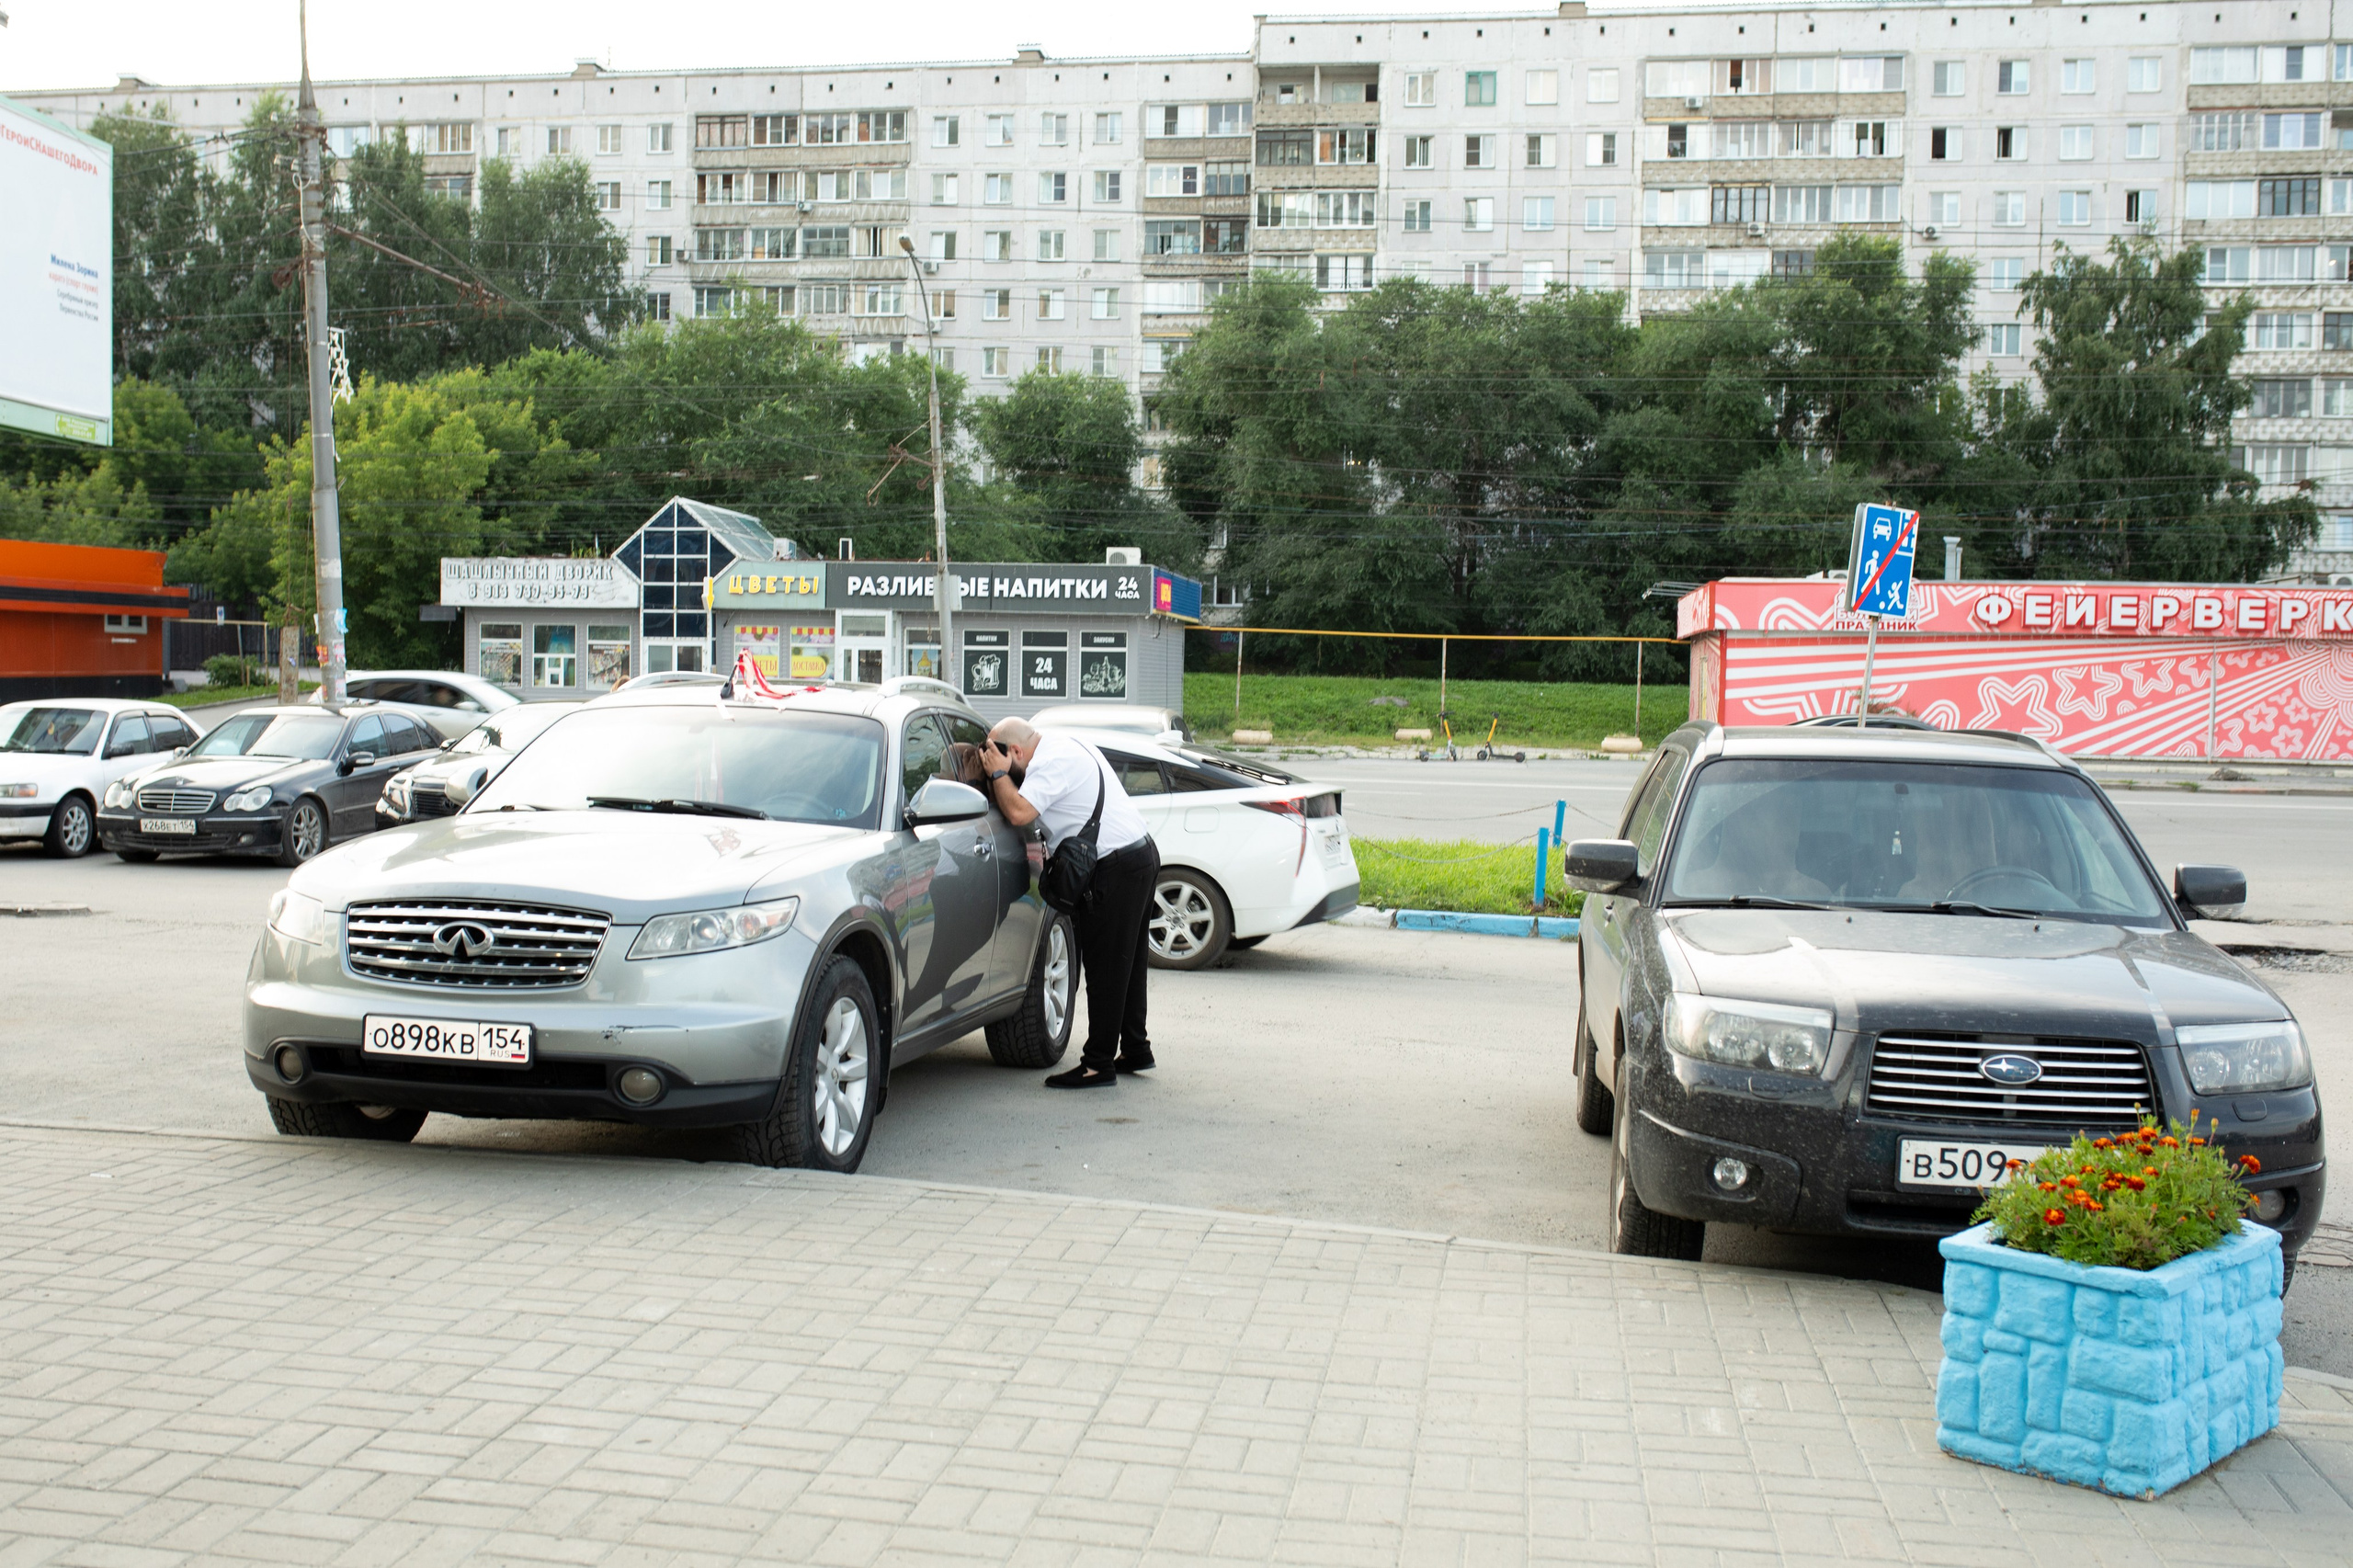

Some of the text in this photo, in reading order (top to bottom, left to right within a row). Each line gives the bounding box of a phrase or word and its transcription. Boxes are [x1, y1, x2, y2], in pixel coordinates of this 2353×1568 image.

[447, 563, 613, 581] ШАШЛЫЧНЫЙ ДВОРИК
[469, 584, 478, 598] 8
[728, 574, 820, 595] ЦВЕТЫ
[847, 575, 1108, 599] РАЗЛИВЫЕ НАПИТКИ
[1118, 576, 1139, 591] 24
[1114, 590, 1141, 599] ЧАСА
[1974, 593, 2353, 633] ФЕЙЕРВЕРК
[792, 661, 824, 671] ДОСТАВКА
[1035, 657, 1053, 674] 24
[1029, 677, 1058, 690] ЧАСА
[483, 1028, 522, 1051] 154
[490, 1050, 510, 1059] RUS
[1913, 1147, 2042, 1185] В509
